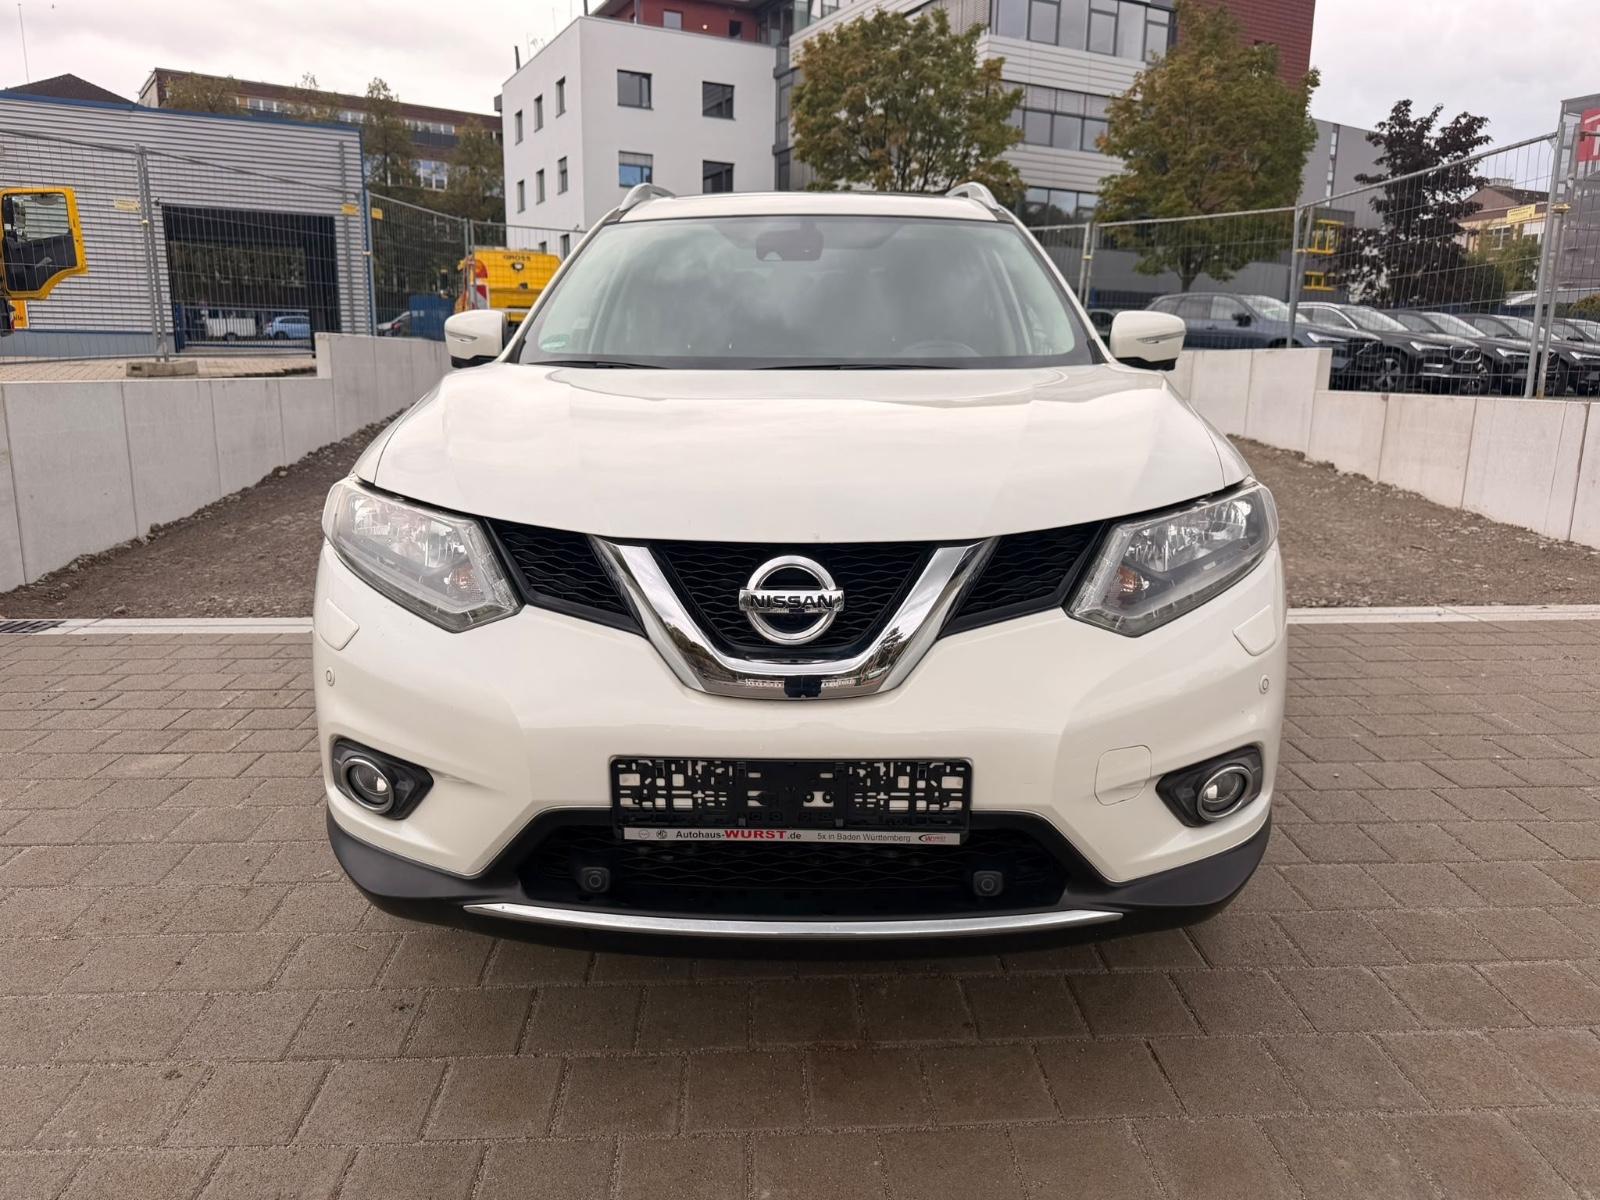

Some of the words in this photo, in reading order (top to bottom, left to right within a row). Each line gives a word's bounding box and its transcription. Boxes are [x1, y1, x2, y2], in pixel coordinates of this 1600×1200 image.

[751, 594, 833, 609] NISSAN
[676, 830, 802, 839] Autohaus-WURST.de
[817, 832, 826, 840] 5x
[828, 832, 835, 840] in
[837, 833, 861, 841] Baden
[862, 833, 911, 842] Württemberg
